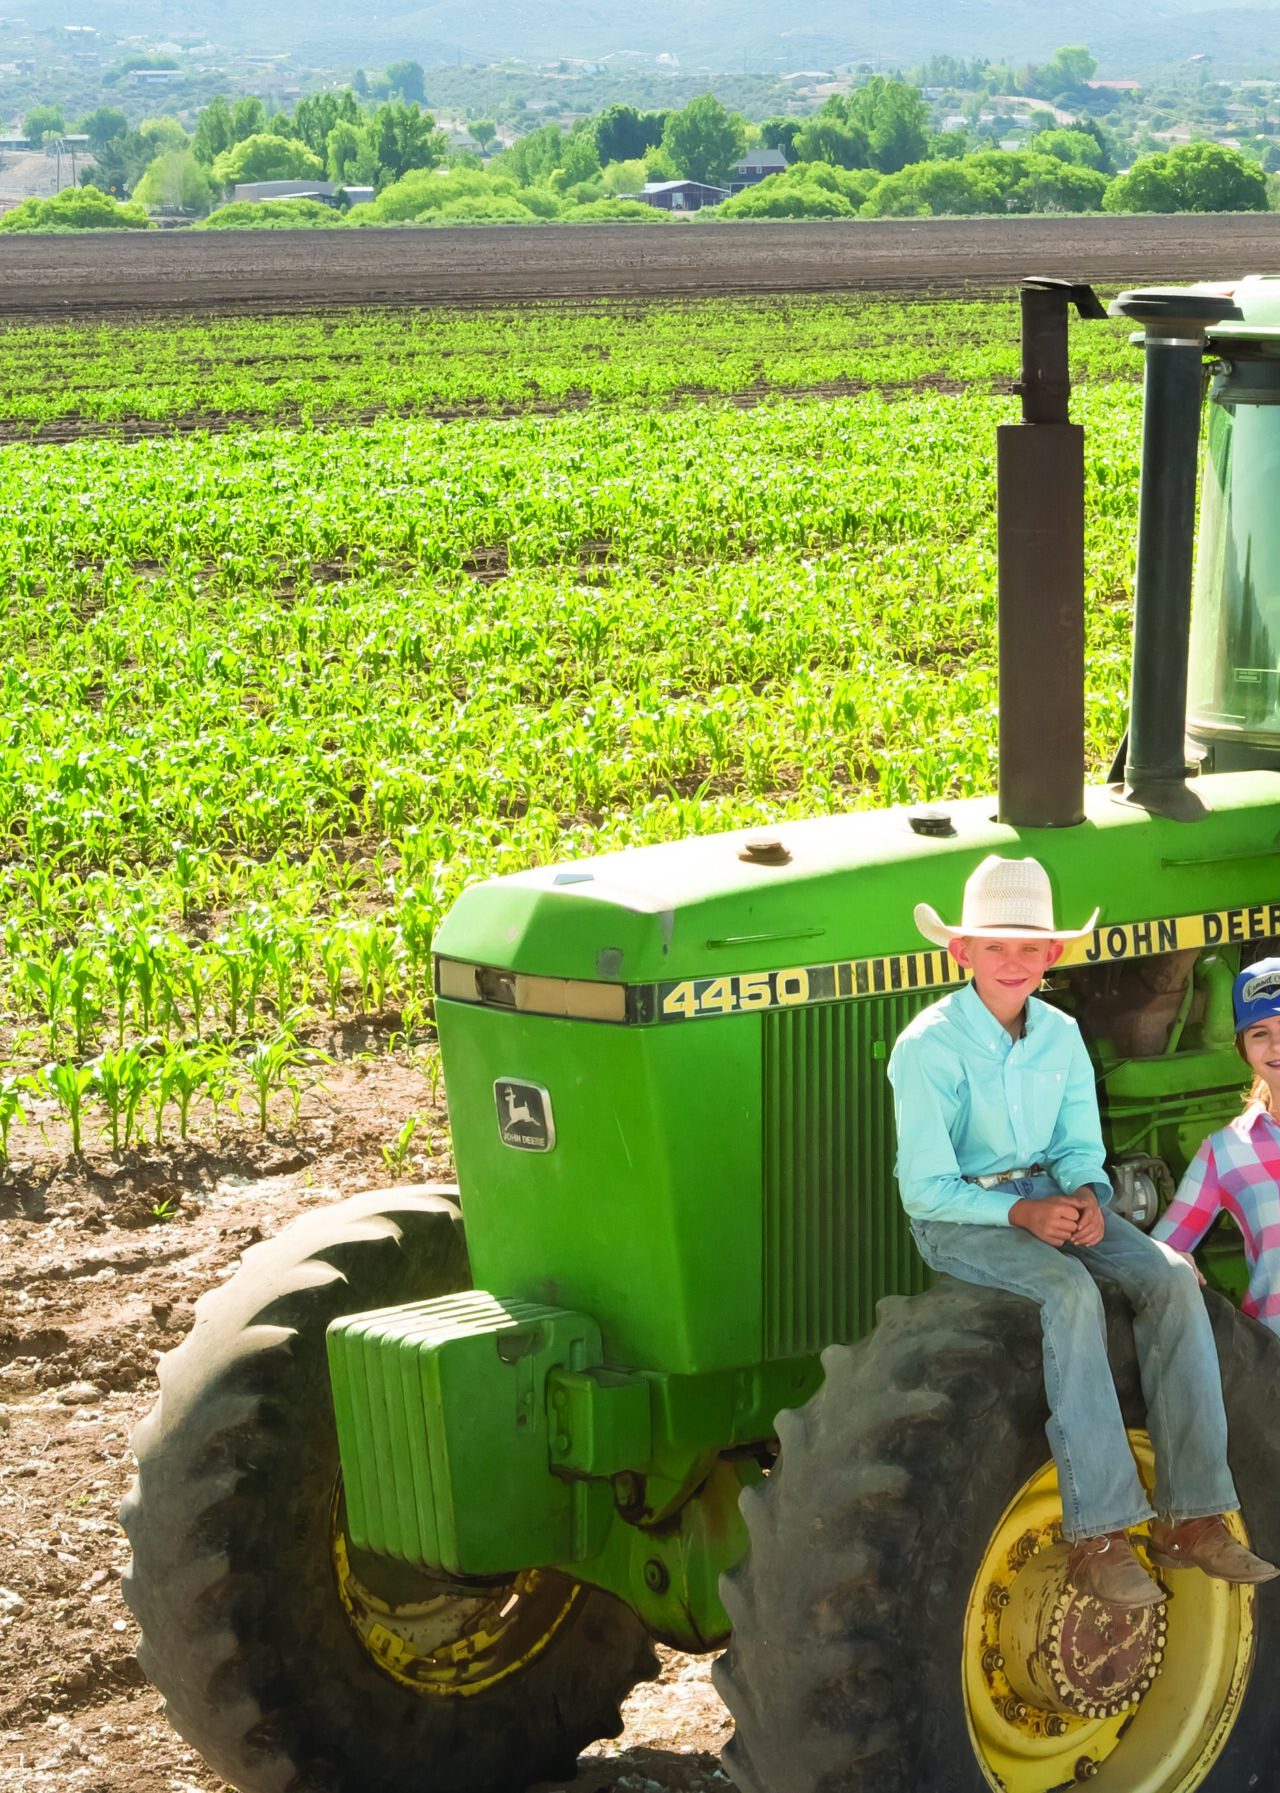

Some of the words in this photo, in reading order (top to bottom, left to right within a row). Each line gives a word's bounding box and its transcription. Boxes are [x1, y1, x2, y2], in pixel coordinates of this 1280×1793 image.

[1085, 919, 1178, 962] JOHN
[663, 967, 810, 1018] 4450
[503, 1132, 522, 1143] JOHN
[522, 1135, 546, 1147] DEERE
